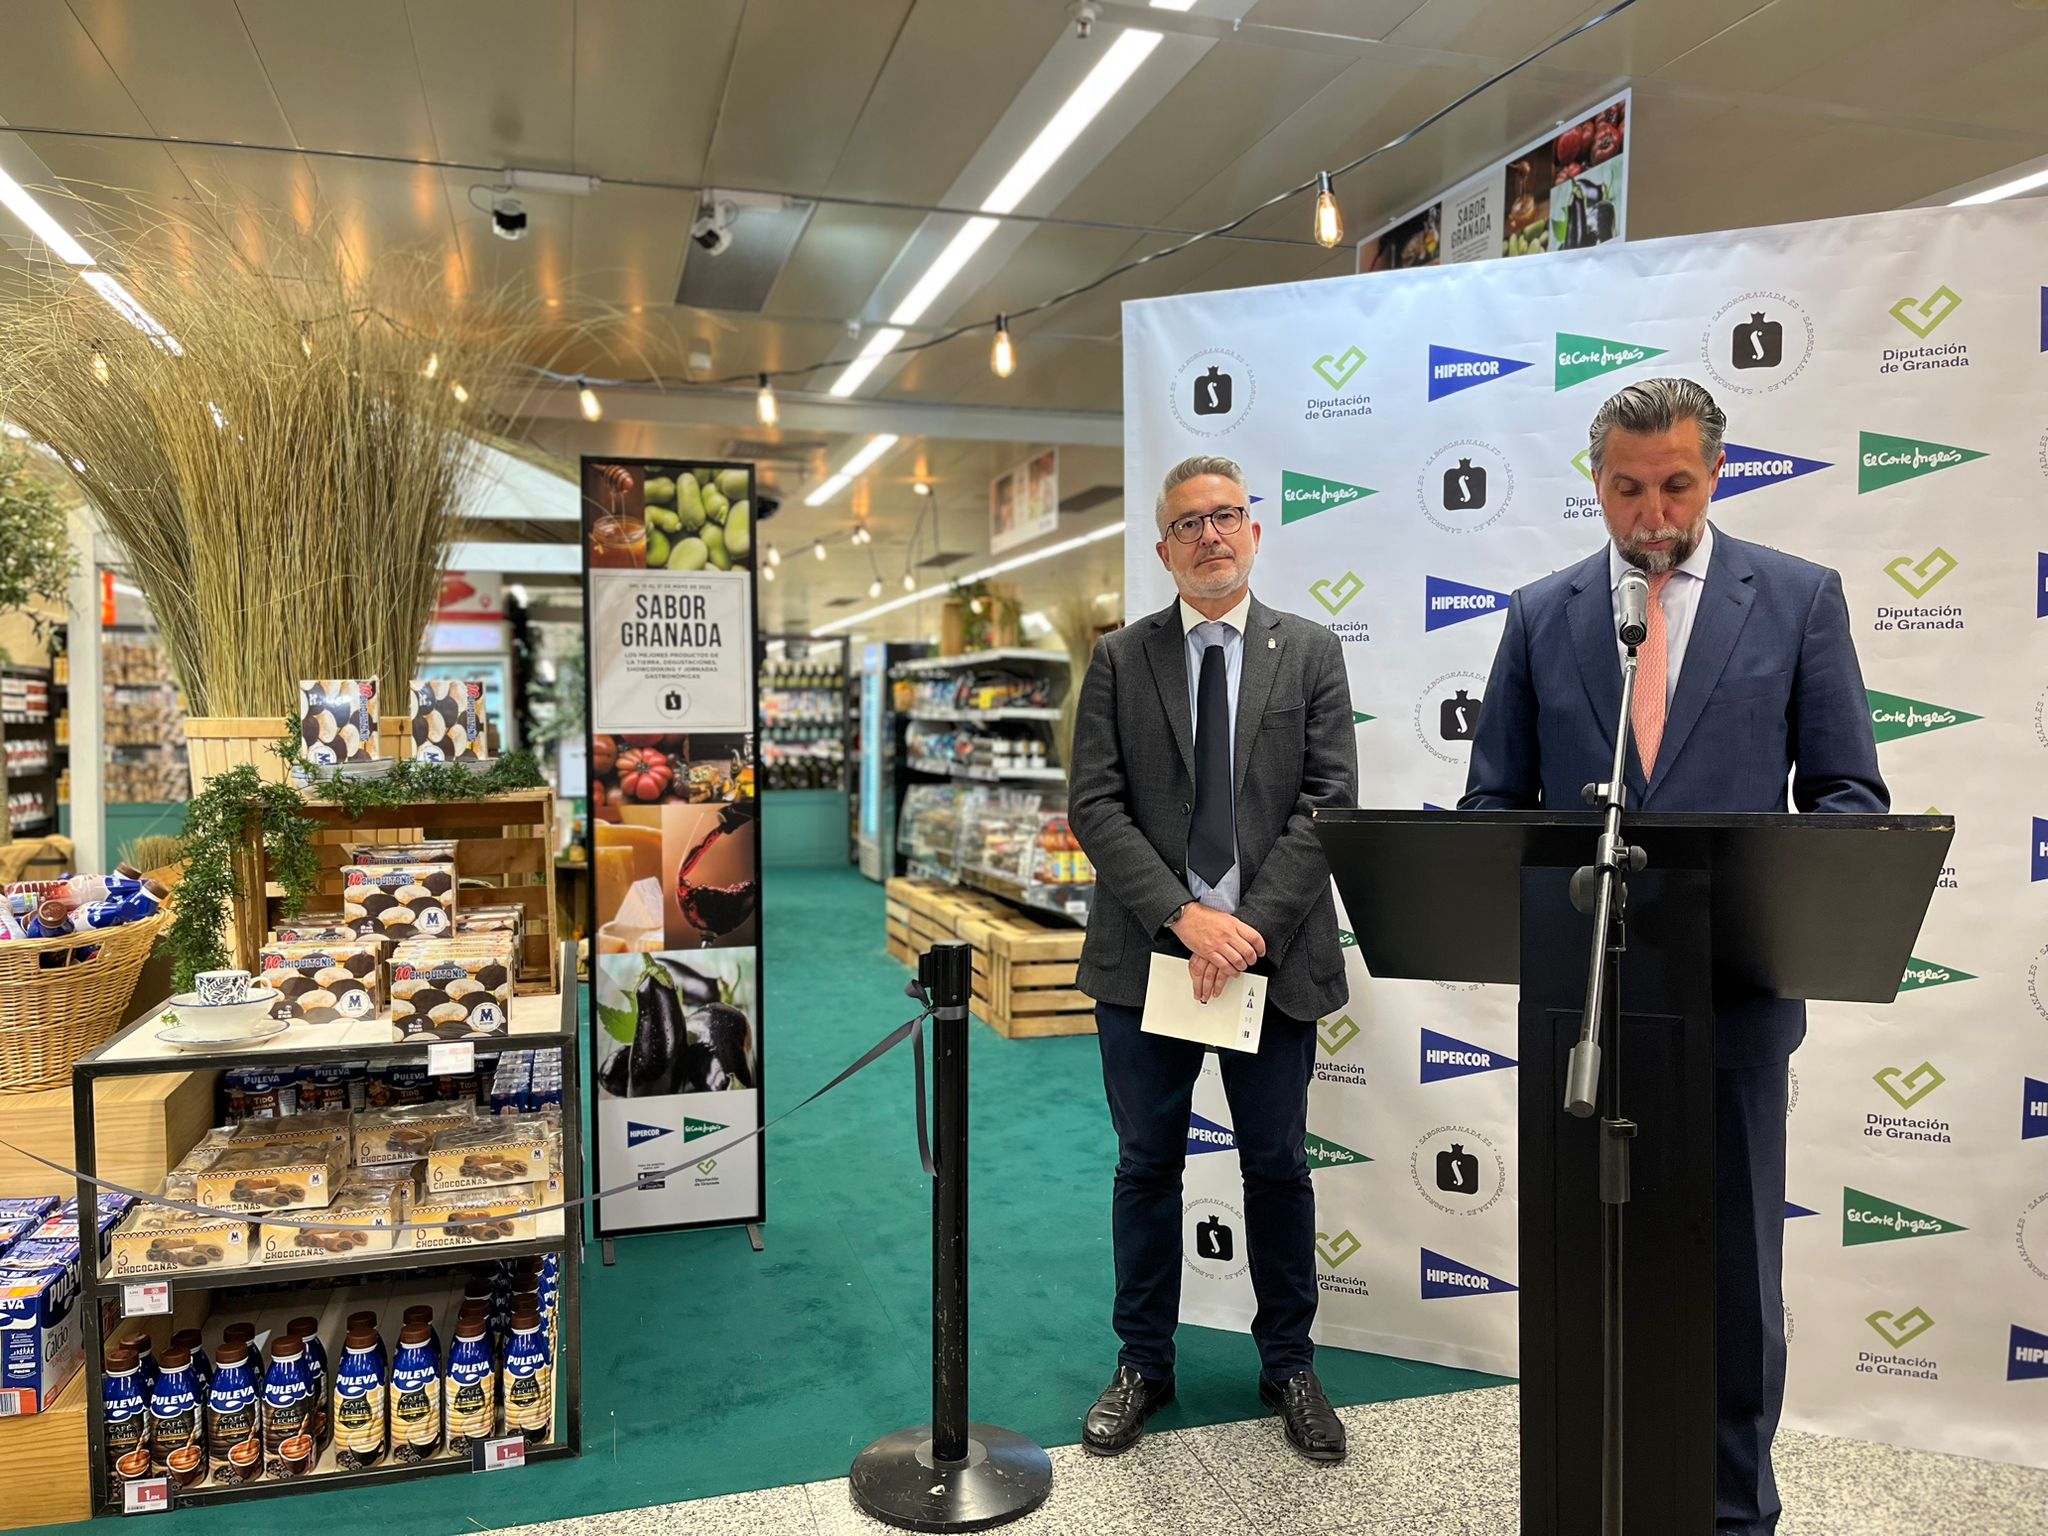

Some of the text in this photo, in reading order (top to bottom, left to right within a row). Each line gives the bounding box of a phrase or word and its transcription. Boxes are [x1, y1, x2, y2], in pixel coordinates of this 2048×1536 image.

[1457, 197, 1486, 227] SABOR
[1451, 214, 1492, 248] GRANADA
[1559, 355, 1570, 366] El
[1571, 351, 1599, 364] Corte
[1883, 343, 1967, 363] Diputación
[1434, 361, 1500, 379] HIPERCOR
[1880, 356, 1969, 374] de Granada
[1307, 394, 1370, 410] Diputación
[1305, 406, 1372, 420] de Granada
[1863, 453, 1878, 468] El
[1878, 452, 1912, 466] Corte
[1285, 488, 1296, 502] El
[1296, 489, 1321, 501] Corte
[1563, 509, 1579, 518] de
[636, 594, 706, 620] SABOR
[1431, 594, 1496, 611] HIPERCOR
[1877, 605, 1962, 619] Diputación
[1874, 619, 1964, 631] de Granada
[621, 622, 722, 648] GRANADA
[1872, 709, 1907, 723] Corte
[348, 873, 415, 886] 10 CHIQUITONIS
[264, 956, 336, 969] 10 CHIQUITONIS
[395, 966, 467, 981] 10 CHIQUITONIS
[1426, 1049, 1491, 1067] HIPERCOR
[243, 1075, 280, 1085] PULEVA
[315, 1068, 350, 1077] PULEVA
[393, 1073, 425, 1081] PULEVA
[1317, 1071, 1367, 1085] Granada
[1867, 1114, 1949, 1130] Diputación
[630, 1129, 660, 1137] HIPERCOR
[1864, 1126, 1951, 1143] de Granada
[361, 1142, 370, 1156] 6
[433, 1166, 444, 1182] 6
[202, 1189, 213, 1205] 6
[1847, 1209, 1861, 1222] El
[1861, 1211, 1894, 1226] Corte
[265, 1234, 276, 1251] 6
[117, 1249, 129, 1266] 6
[1426, 1269, 1490, 1291] HIPERCOR
[1320, 1282, 1369, 1296] Granada
[507, 1353, 544, 1366] PULEVA
[1859, 1352, 1936, 1369] Diputación
[393, 1366, 435, 1380] PULEVA
[451, 1361, 489, 1374] PULEVA
[1856, 1363, 1938, 1380] de Granada
[336, 1373, 378, 1386] PULEVA
[210, 1386, 255, 1401] PULEVA
[265, 1382, 306, 1395] PULEVA
[106, 1395, 143, 1410] ULEVA
[151, 1392, 194, 1406] PULEVA
[273, 1416, 299, 1425] LECHE
